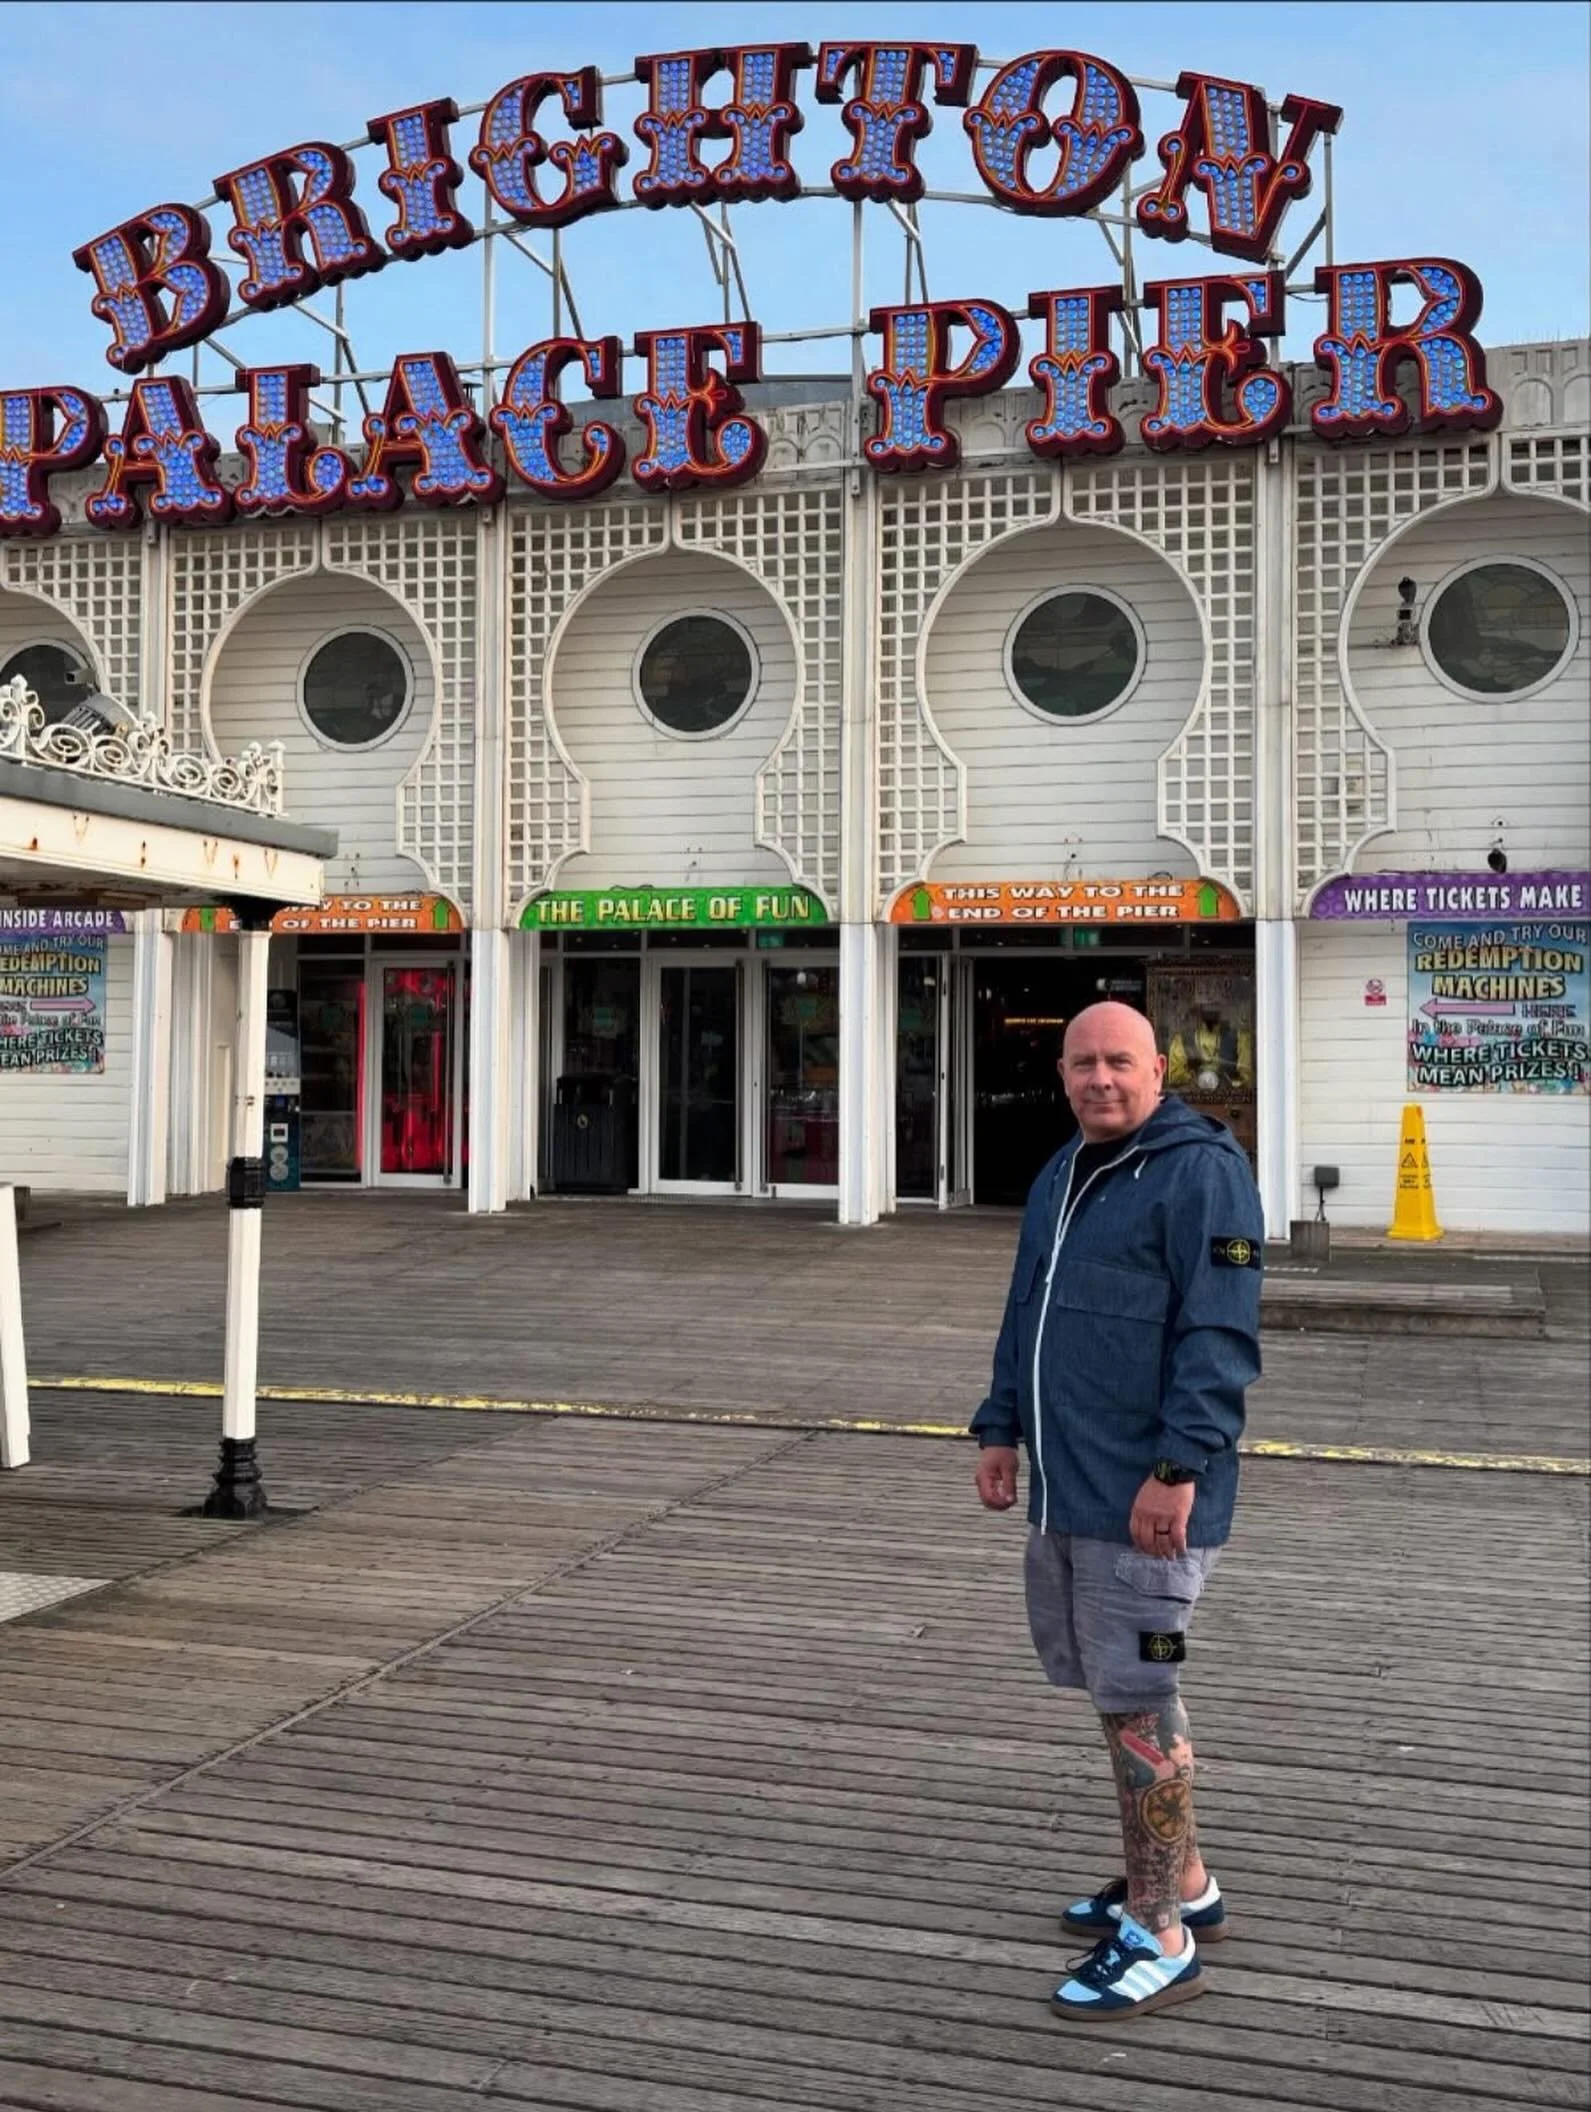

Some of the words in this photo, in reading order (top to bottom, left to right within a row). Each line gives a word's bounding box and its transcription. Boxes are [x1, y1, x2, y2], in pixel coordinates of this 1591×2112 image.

[73, 41, 1344, 375] BRIGHTON
[0, 321, 768, 538] PALACE
[864, 257, 1503, 474] PIER
[944, 887, 1000, 899] THIS
[1010, 887, 1074, 899] WAY
[1084, 886, 1122, 898] TO
[1133, 885, 1183, 897] THE
[1344, 888, 1417, 912] WHERE
[1426, 886, 1511, 910] TICKETS
[1520, 885, 1582, 909] MAKE
[342, 900, 372, 911] TO
[381, 900, 423, 911] THE
[535, 899, 584, 922] THE
[598, 898, 695, 921] PALACE
[708, 896, 741, 919] OF
[755, 895, 809, 919] FUN
[948, 907, 1001, 919] END
[1012, 906, 1048, 919] OF
[1057, 906, 1107, 918] THE
[1117, 906, 1179, 918] PIER
[53, 909, 114, 928] ARCADE
[282, 918, 311, 929] OF
[320, 918, 365, 929] THE
[367, 917, 417, 929] PIER
[1413, 932, 1463, 949] COME
[1467, 930, 1505, 948] AND
[1512, 925, 1545, 942] TRY
[1549, 923, 1587, 944] OUR
[1417, 946, 1582, 972] REDEMPTION
[0, 976, 88, 998] MACHINES
[1433, 974, 1565, 1000] MACHINES
[40, 1029, 102, 1045] TICKETS
[1412, 1043, 1491, 1063] WHERE
[1496, 1040, 1587, 1060] TICKETS
[1419, 1066, 1484, 1085] MEAN
